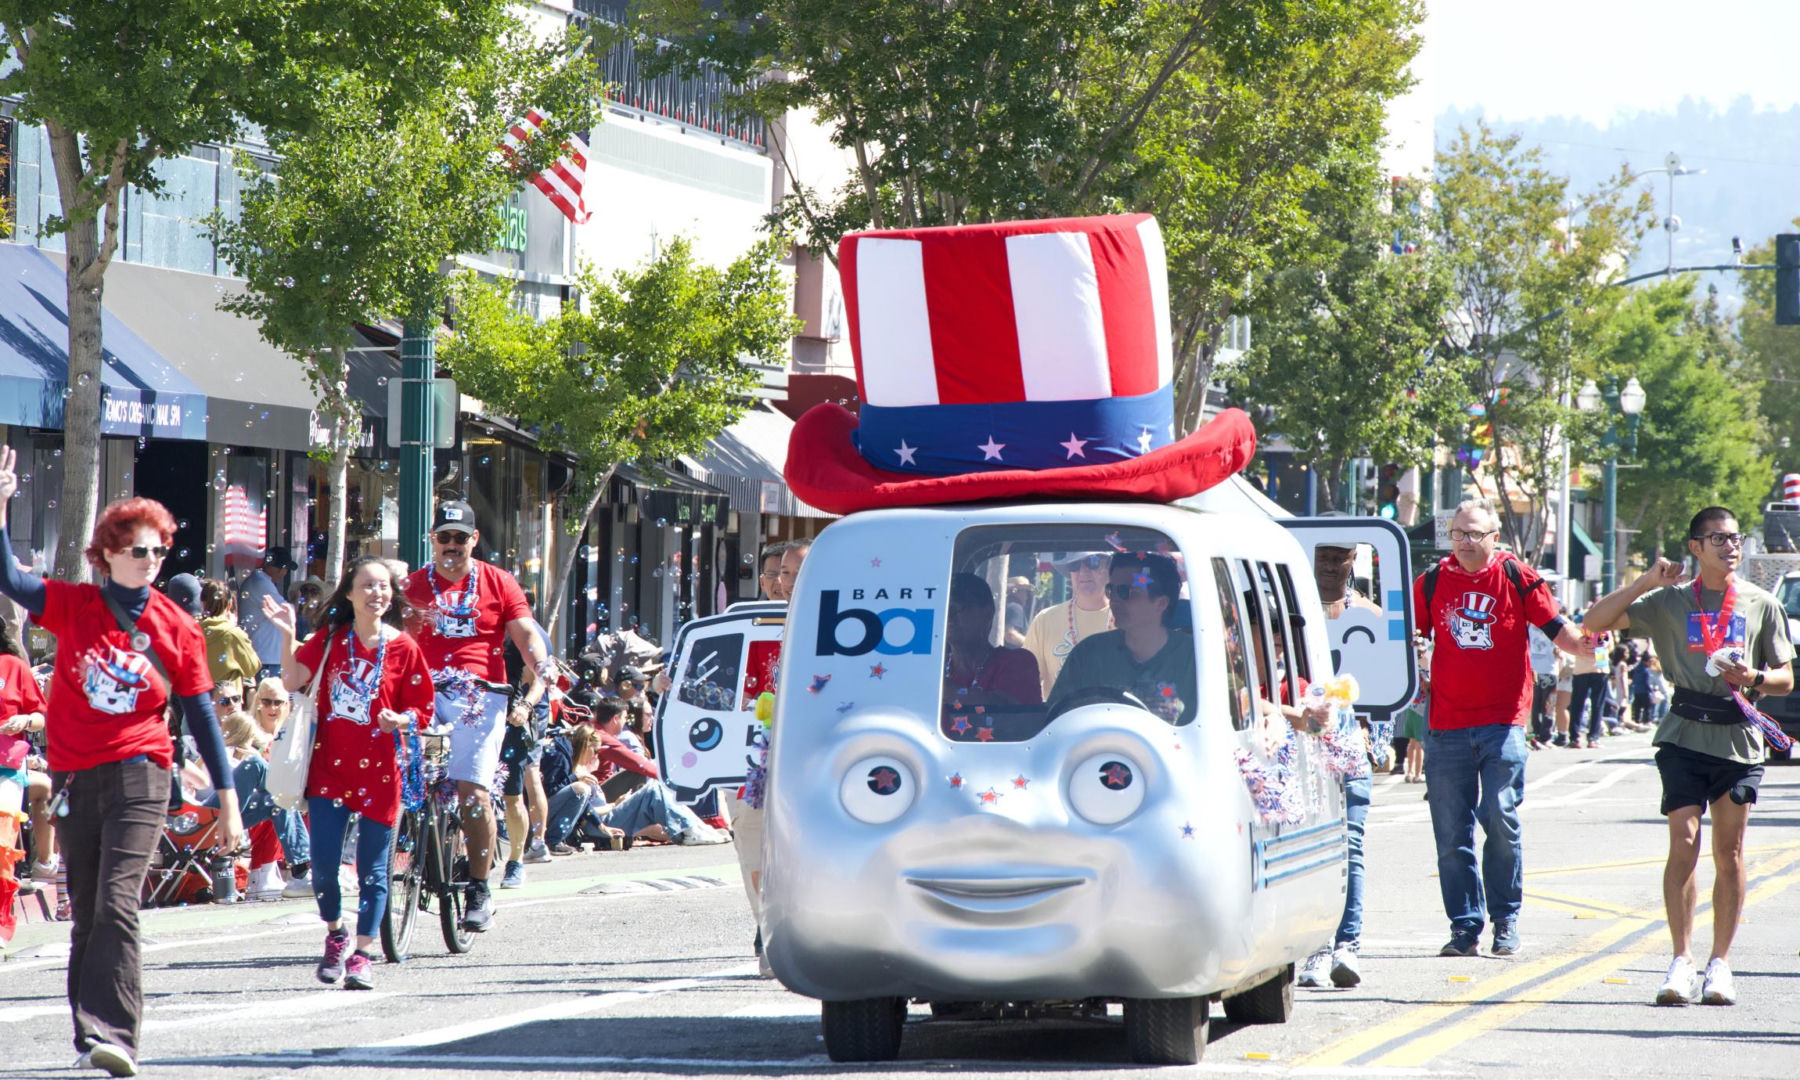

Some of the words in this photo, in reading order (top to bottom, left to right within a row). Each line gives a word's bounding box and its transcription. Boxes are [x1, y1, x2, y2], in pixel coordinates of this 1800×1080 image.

[156, 404, 169, 426] NAIL
[170, 405, 181, 427] SPA
[852, 588, 937, 600] BART
